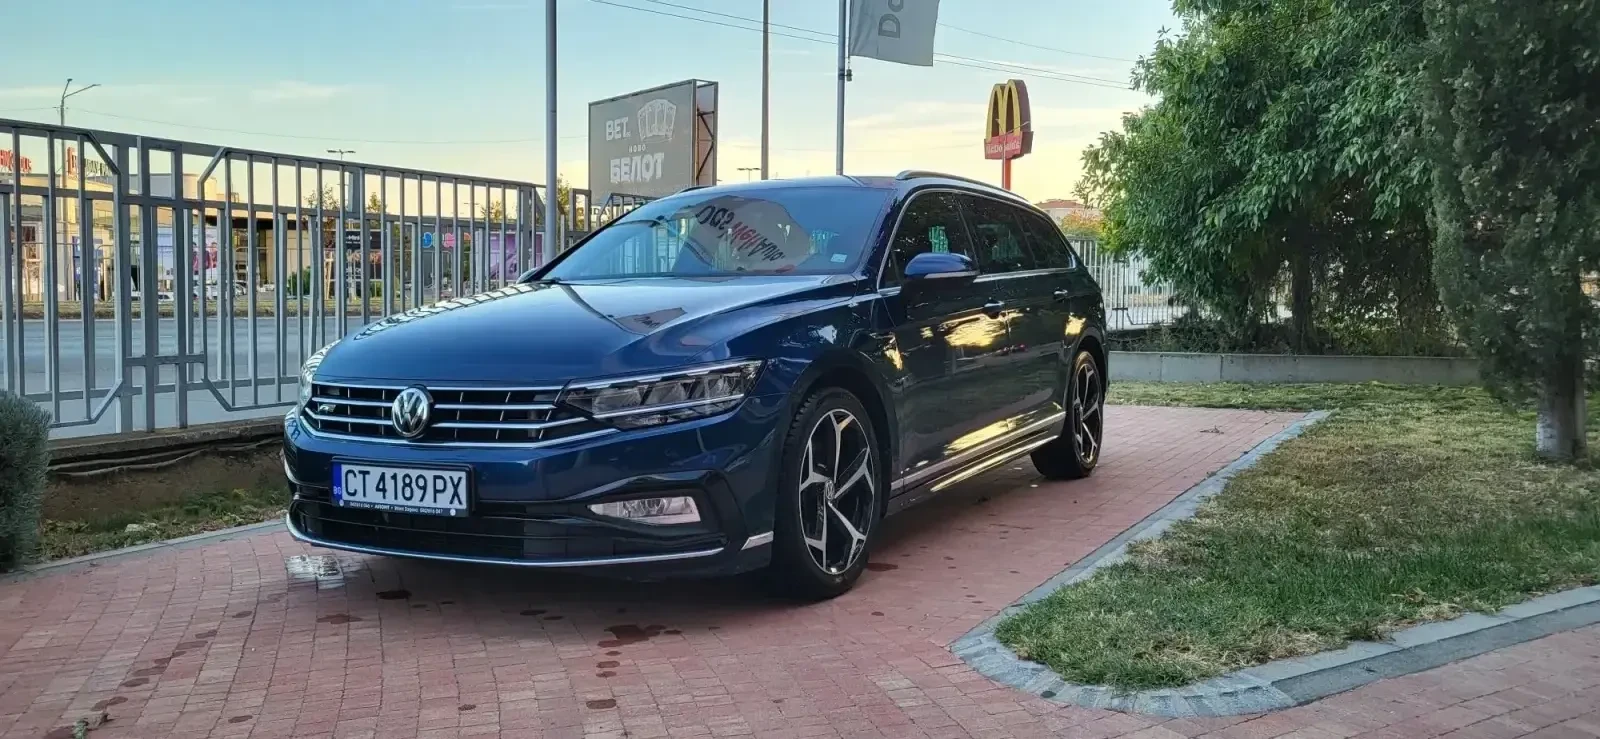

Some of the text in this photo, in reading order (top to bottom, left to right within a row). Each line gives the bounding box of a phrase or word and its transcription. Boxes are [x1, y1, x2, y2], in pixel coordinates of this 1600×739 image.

[987, 138, 1020, 154] McDoald's
[610, 152, 665, 184] БЕЛОТ
[333, 486, 342, 495] BG
[344, 469, 463, 505] CT 4189 PX
